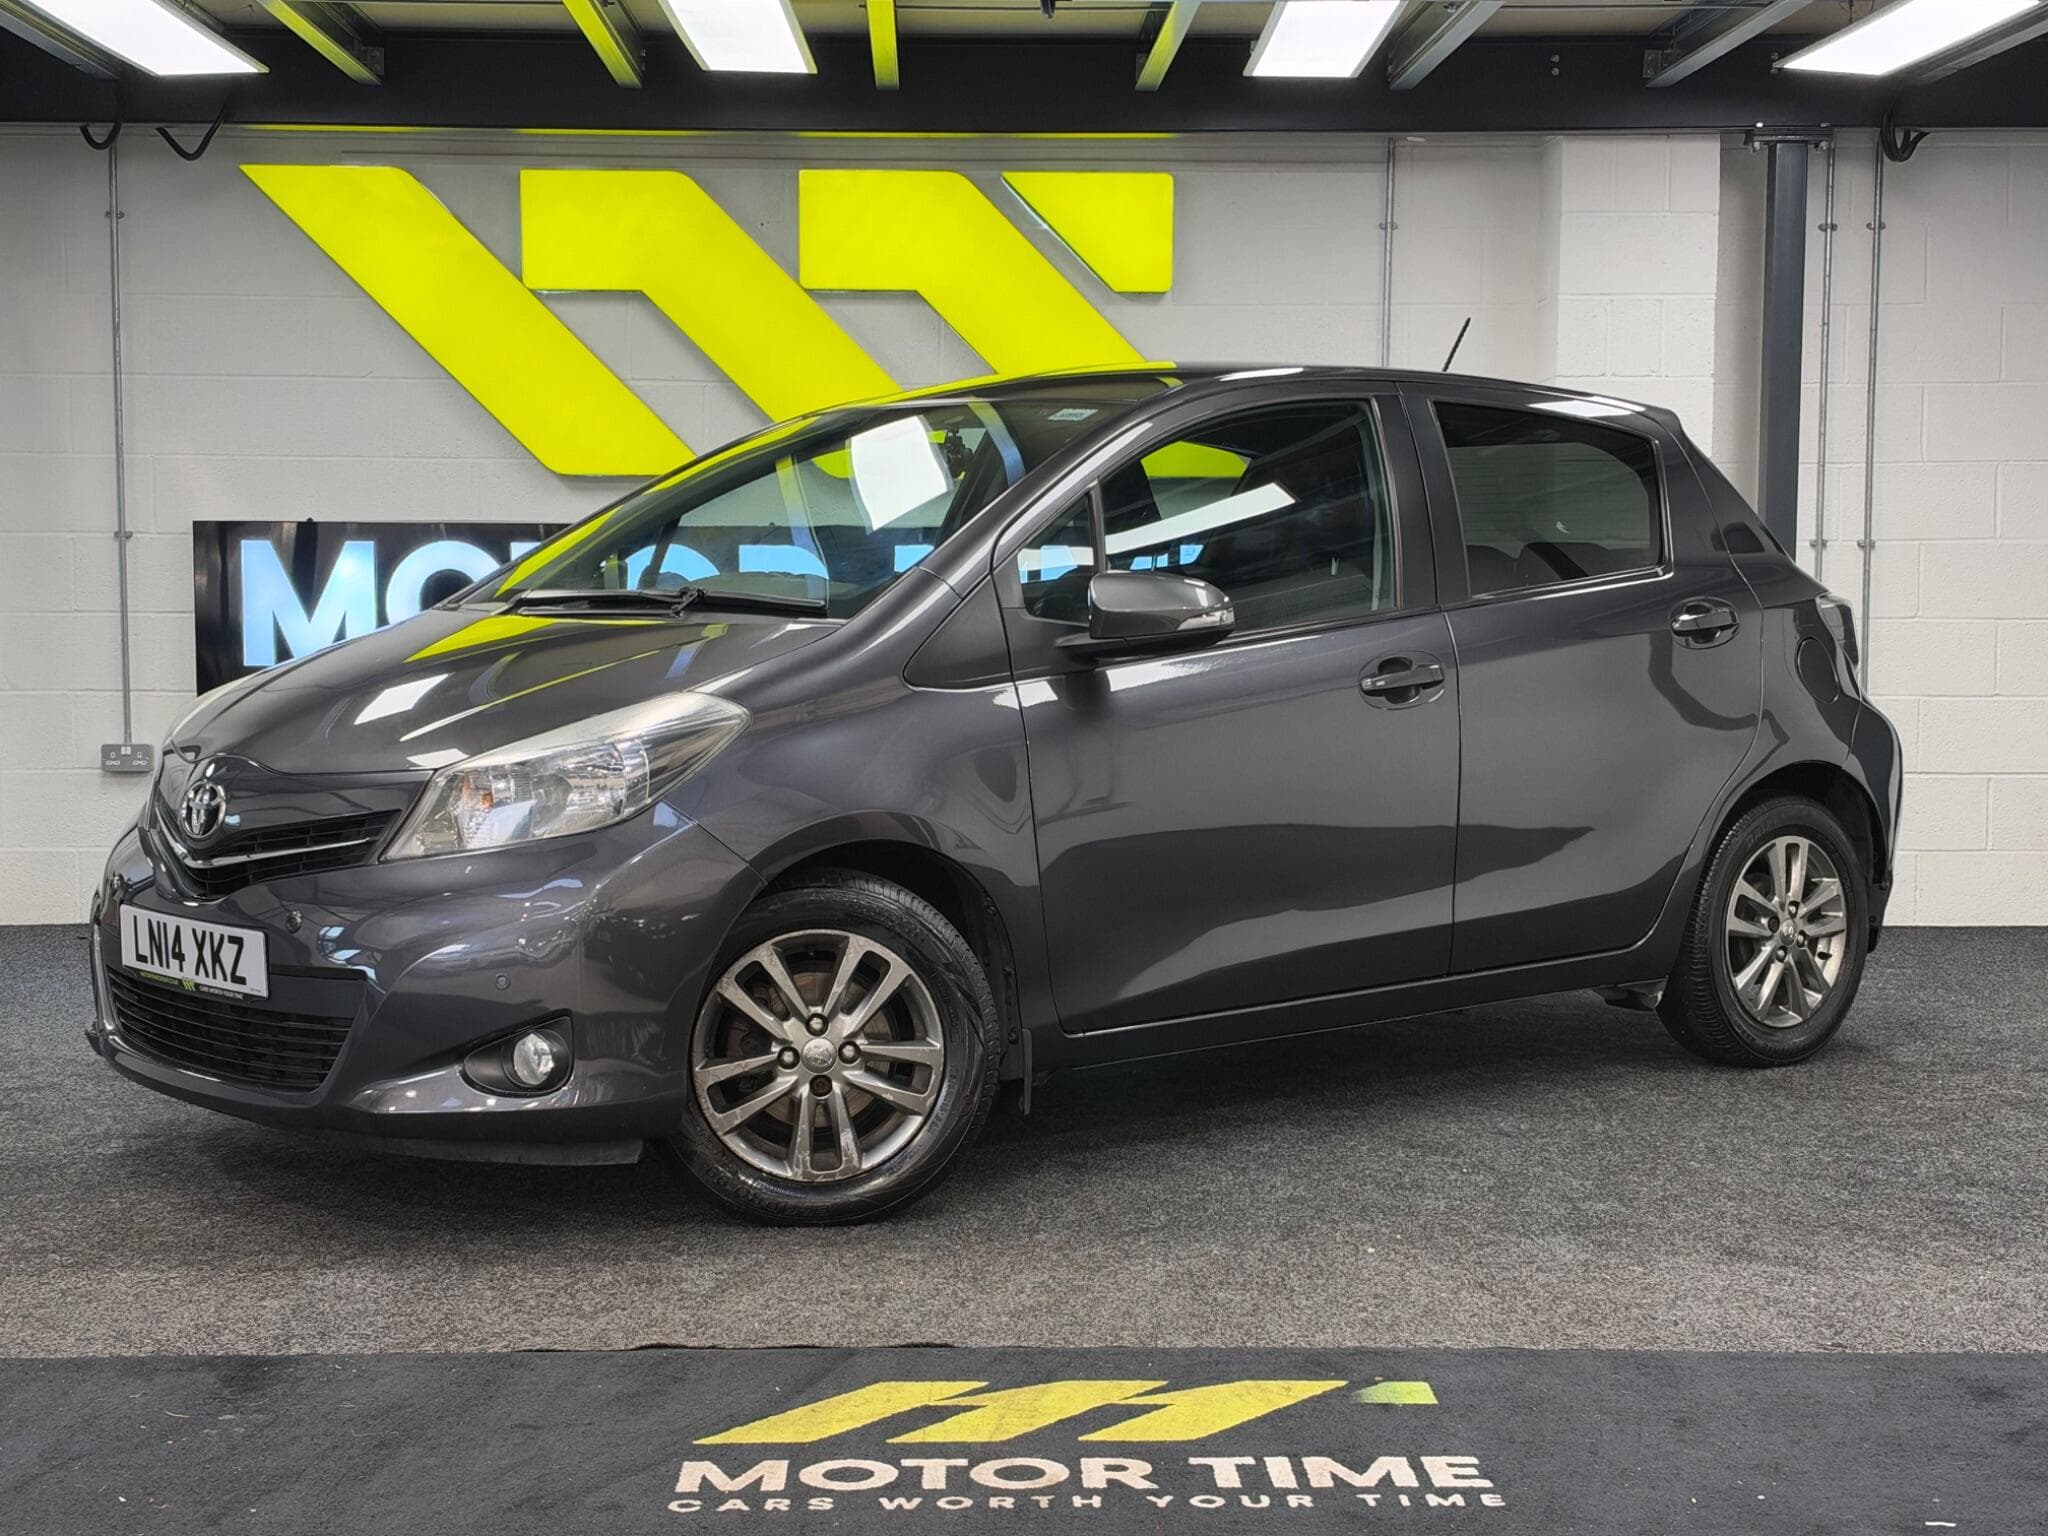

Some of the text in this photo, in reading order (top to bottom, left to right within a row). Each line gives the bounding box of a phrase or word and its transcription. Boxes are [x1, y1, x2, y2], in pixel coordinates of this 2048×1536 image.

[133, 915, 247, 985] LN14 XKZ
[674, 1456, 1494, 1493] MOTOR TIME
[668, 1494, 1507, 1513] CARS WORTH YOUR TIME
